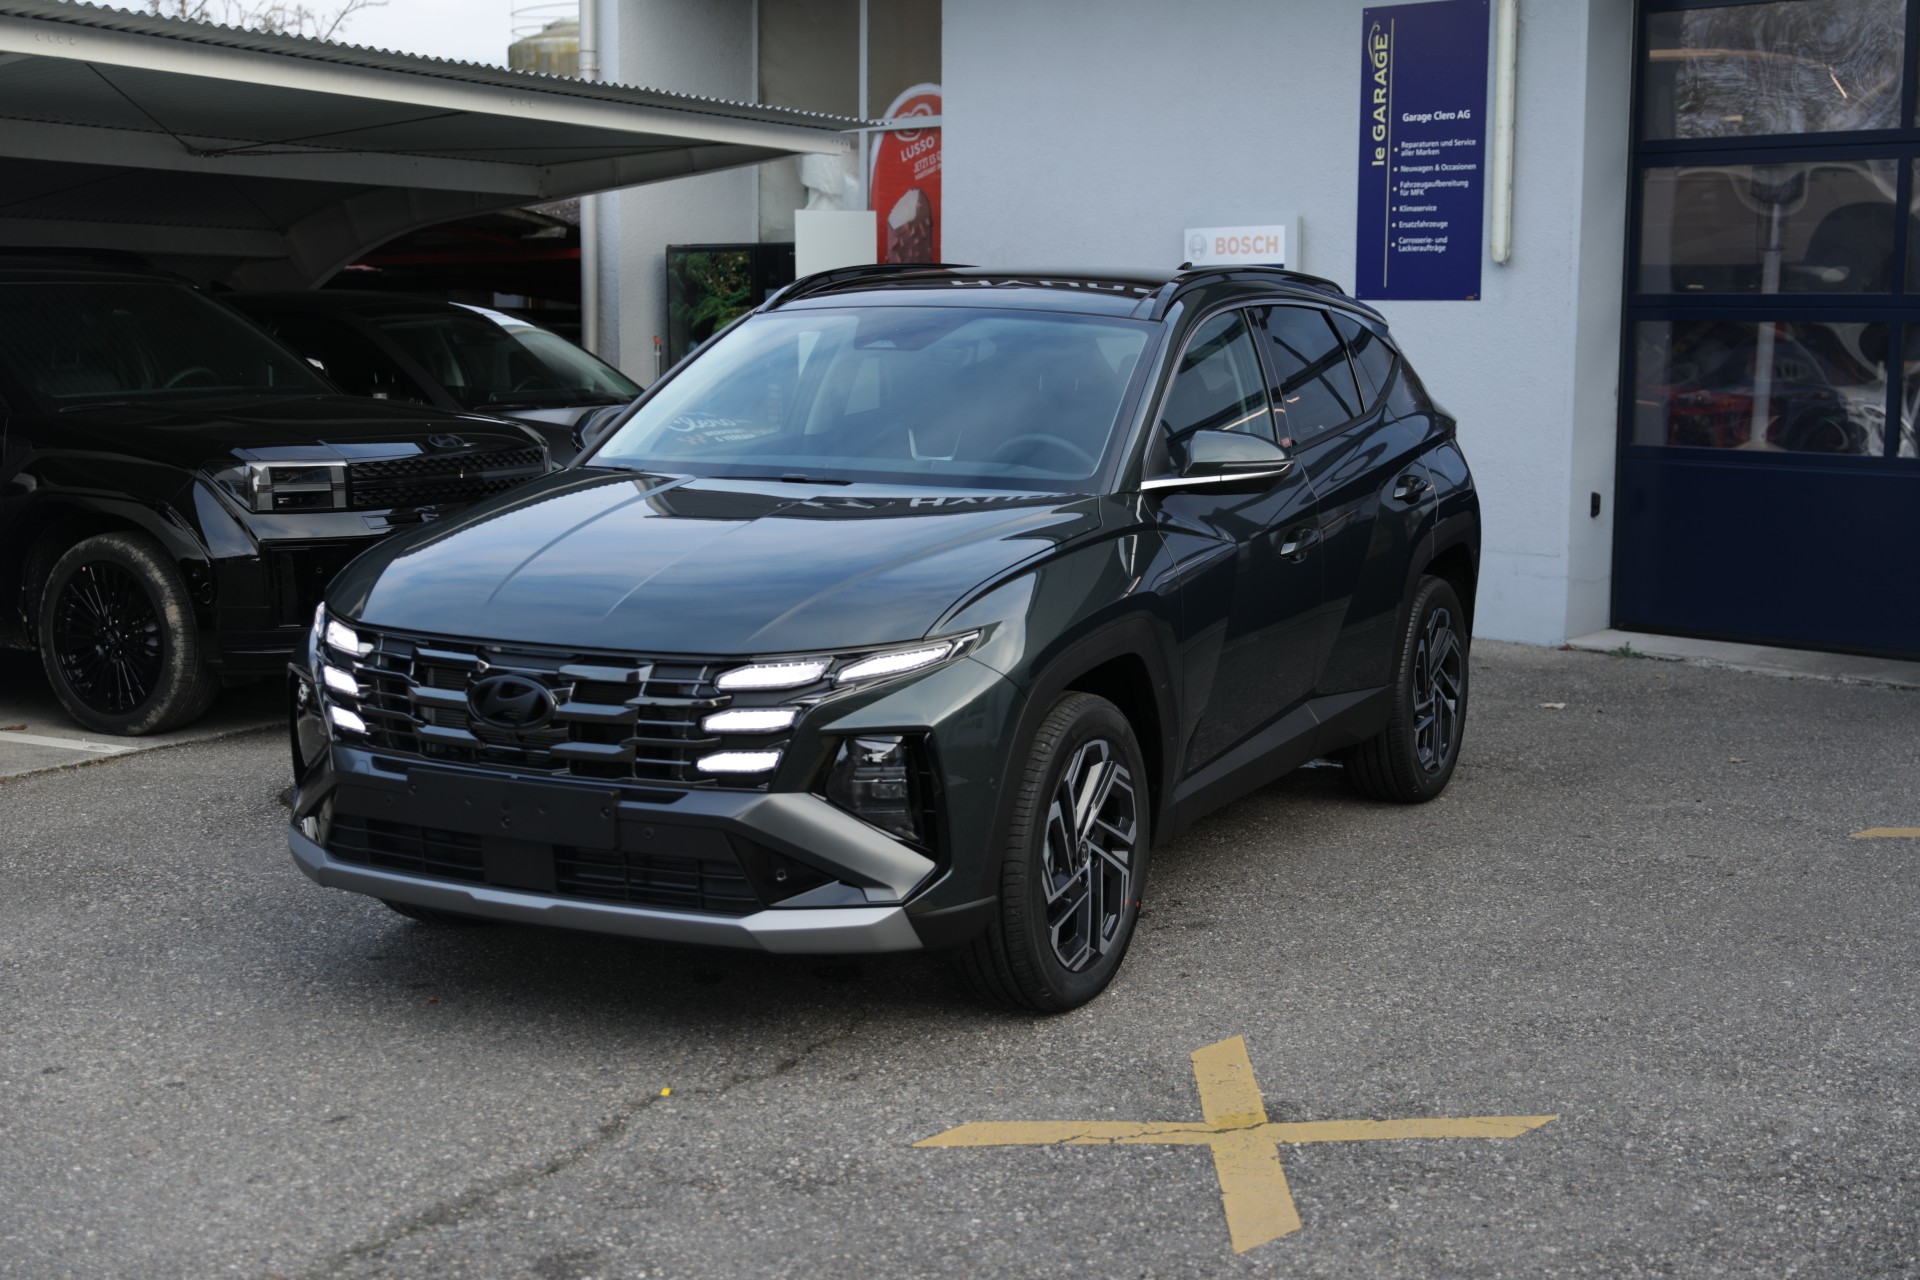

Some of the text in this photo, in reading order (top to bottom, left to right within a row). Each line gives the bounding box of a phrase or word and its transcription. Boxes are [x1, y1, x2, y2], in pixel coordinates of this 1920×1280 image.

[1372, 33, 1388, 166] le GARAGE
[1402, 113, 1432, 123] Garage
[1457, 110, 1471, 119] AG
[900, 135, 935, 162] LUSSO
[1401, 138, 1476, 150] Reparaturen und Service
[1401, 148, 1440, 157] aller Marken
[1400, 162, 1476, 173] Neuwagen & Occasionen
[1400, 180, 1469, 189] Fahrzeugaufbereitung
[1400, 188, 1425, 197] für MFK
[1400, 204, 1437, 212] Klimaservice
[1399, 220, 1448, 229] Ersatzfahrzeuge
[1215, 235, 1279, 255] BOSCH
[1398, 235, 1448, 245] Carrosserie- und
[1398, 244, 1446, 253] Lackieraufträge
